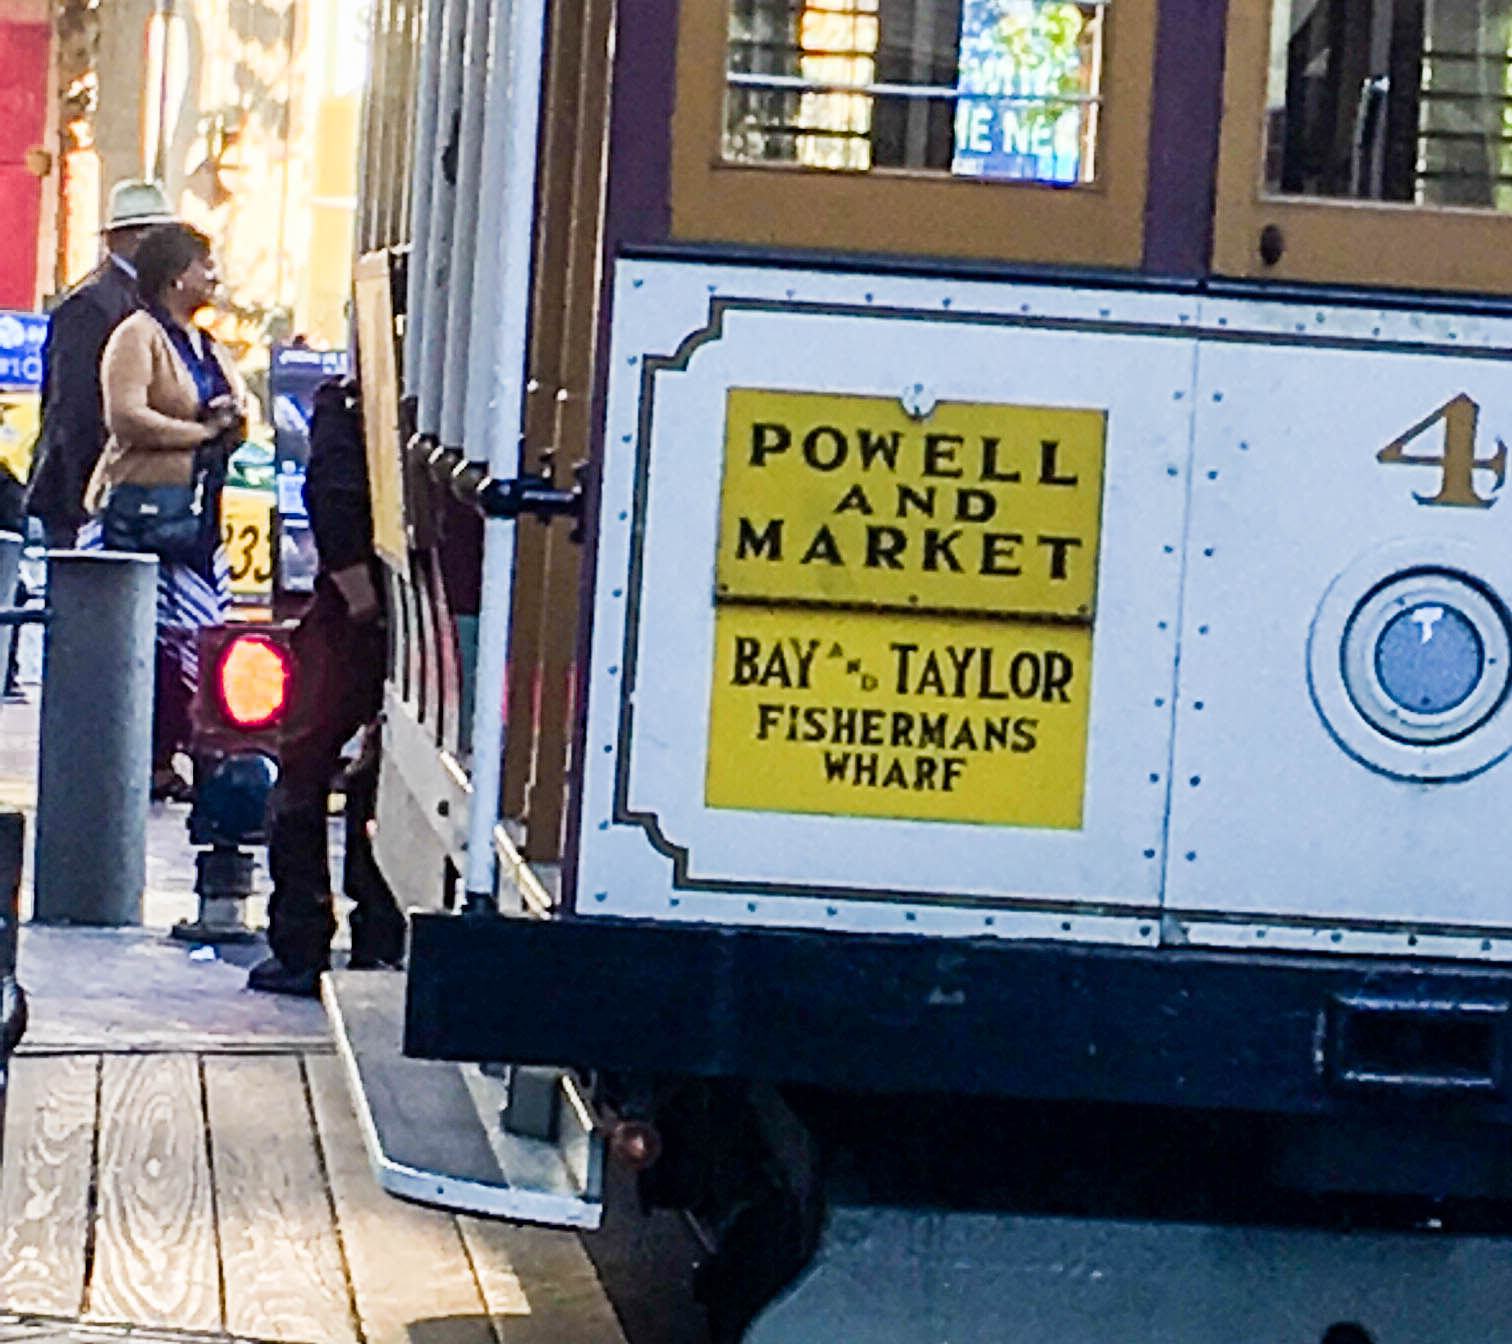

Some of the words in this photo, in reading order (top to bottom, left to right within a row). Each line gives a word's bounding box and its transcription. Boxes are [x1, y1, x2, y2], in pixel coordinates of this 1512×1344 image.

[748, 422, 1079, 486] POWELL
[1376, 392, 1508, 509] 4
[834, 484, 998, 523] AND
[735, 517, 1082, 580] MARKET
[731, 637, 820, 689] BAY
[890, 642, 1074, 703] TAYLOR
[756, 704, 1038, 753] FISHERMANS
[823, 751, 967, 792] WHARF
